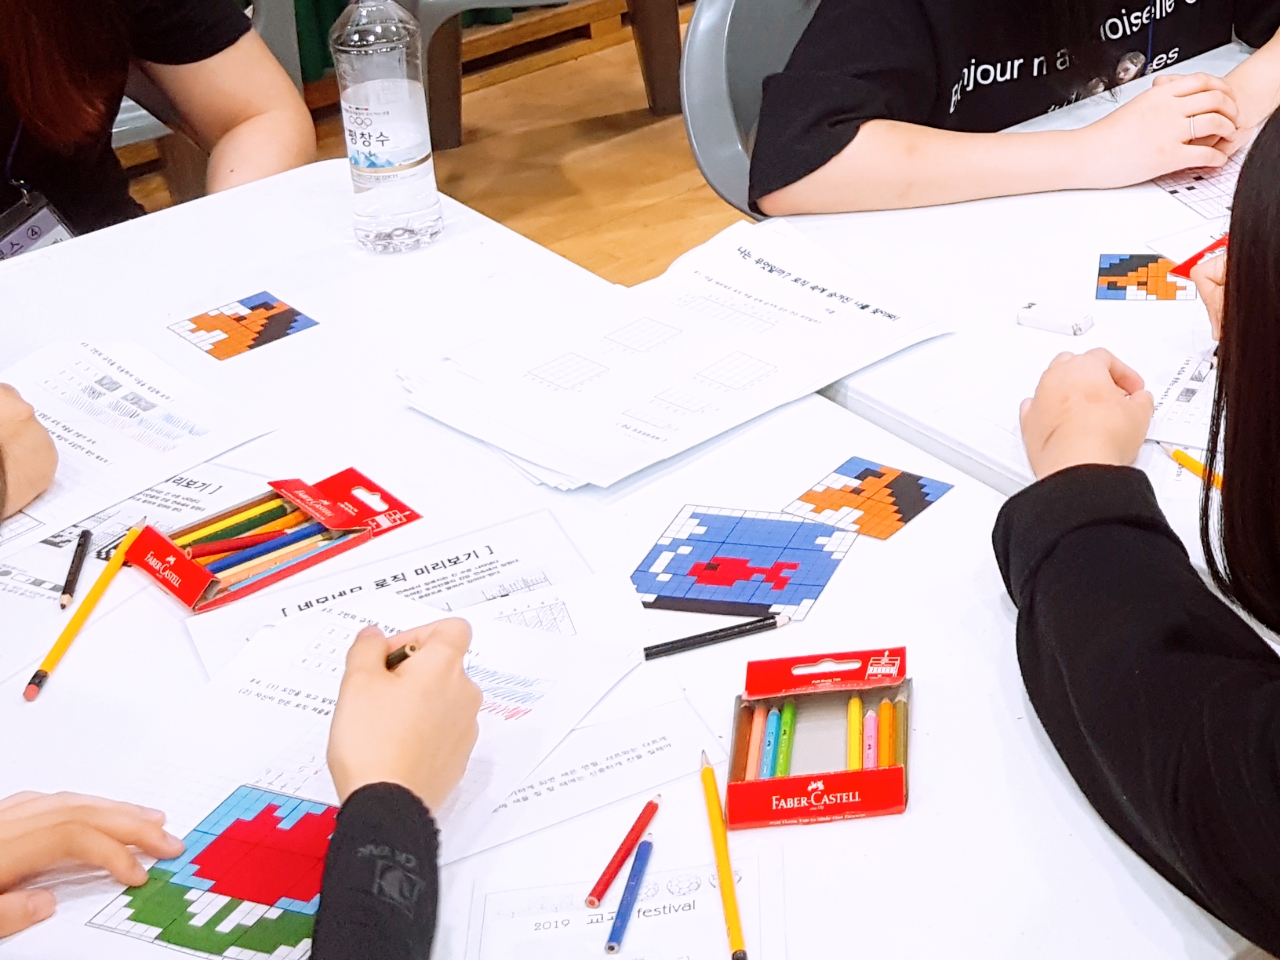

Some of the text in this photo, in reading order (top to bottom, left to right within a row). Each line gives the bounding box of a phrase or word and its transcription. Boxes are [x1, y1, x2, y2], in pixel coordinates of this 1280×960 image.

[348, 128, 390, 148] 평창수
[737, 245, 753, 260] 나는
[144, 550, 183, 588] FABER-CASTELL
[373, 572, 408, 590] 로직
[413, 550, 480, 577] 미리보기
[771, 789, 862, 811] FABER-CASTELL
[533, 918, 571, 932] 2019
[636, 899, 697, 920] festival
